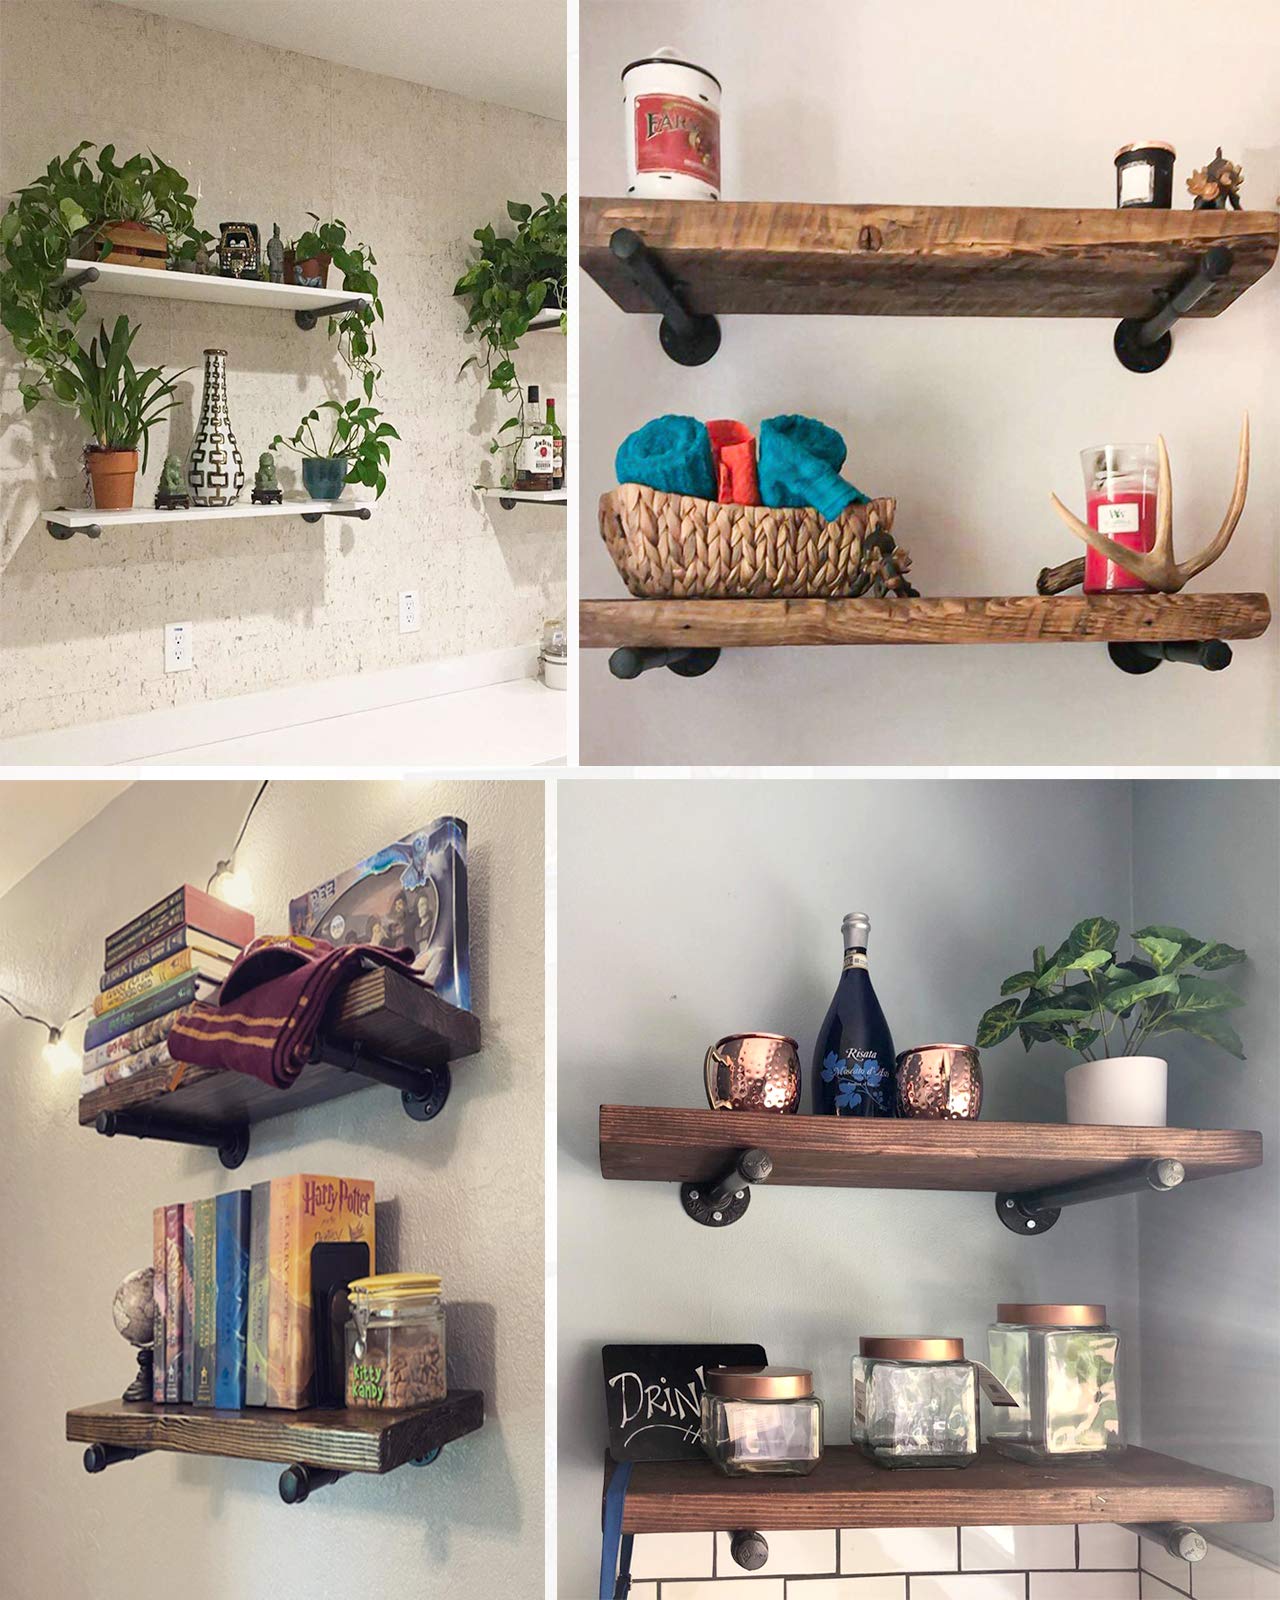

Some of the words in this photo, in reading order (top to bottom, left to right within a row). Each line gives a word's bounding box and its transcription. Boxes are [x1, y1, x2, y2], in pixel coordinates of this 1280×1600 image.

[845, 1047, 878, 1062] Risata
[303, 1180, 338, 1216] Harry
[338, 1178, 371, 1218] Potter
[353, 1361, 383, 1383] kitty
